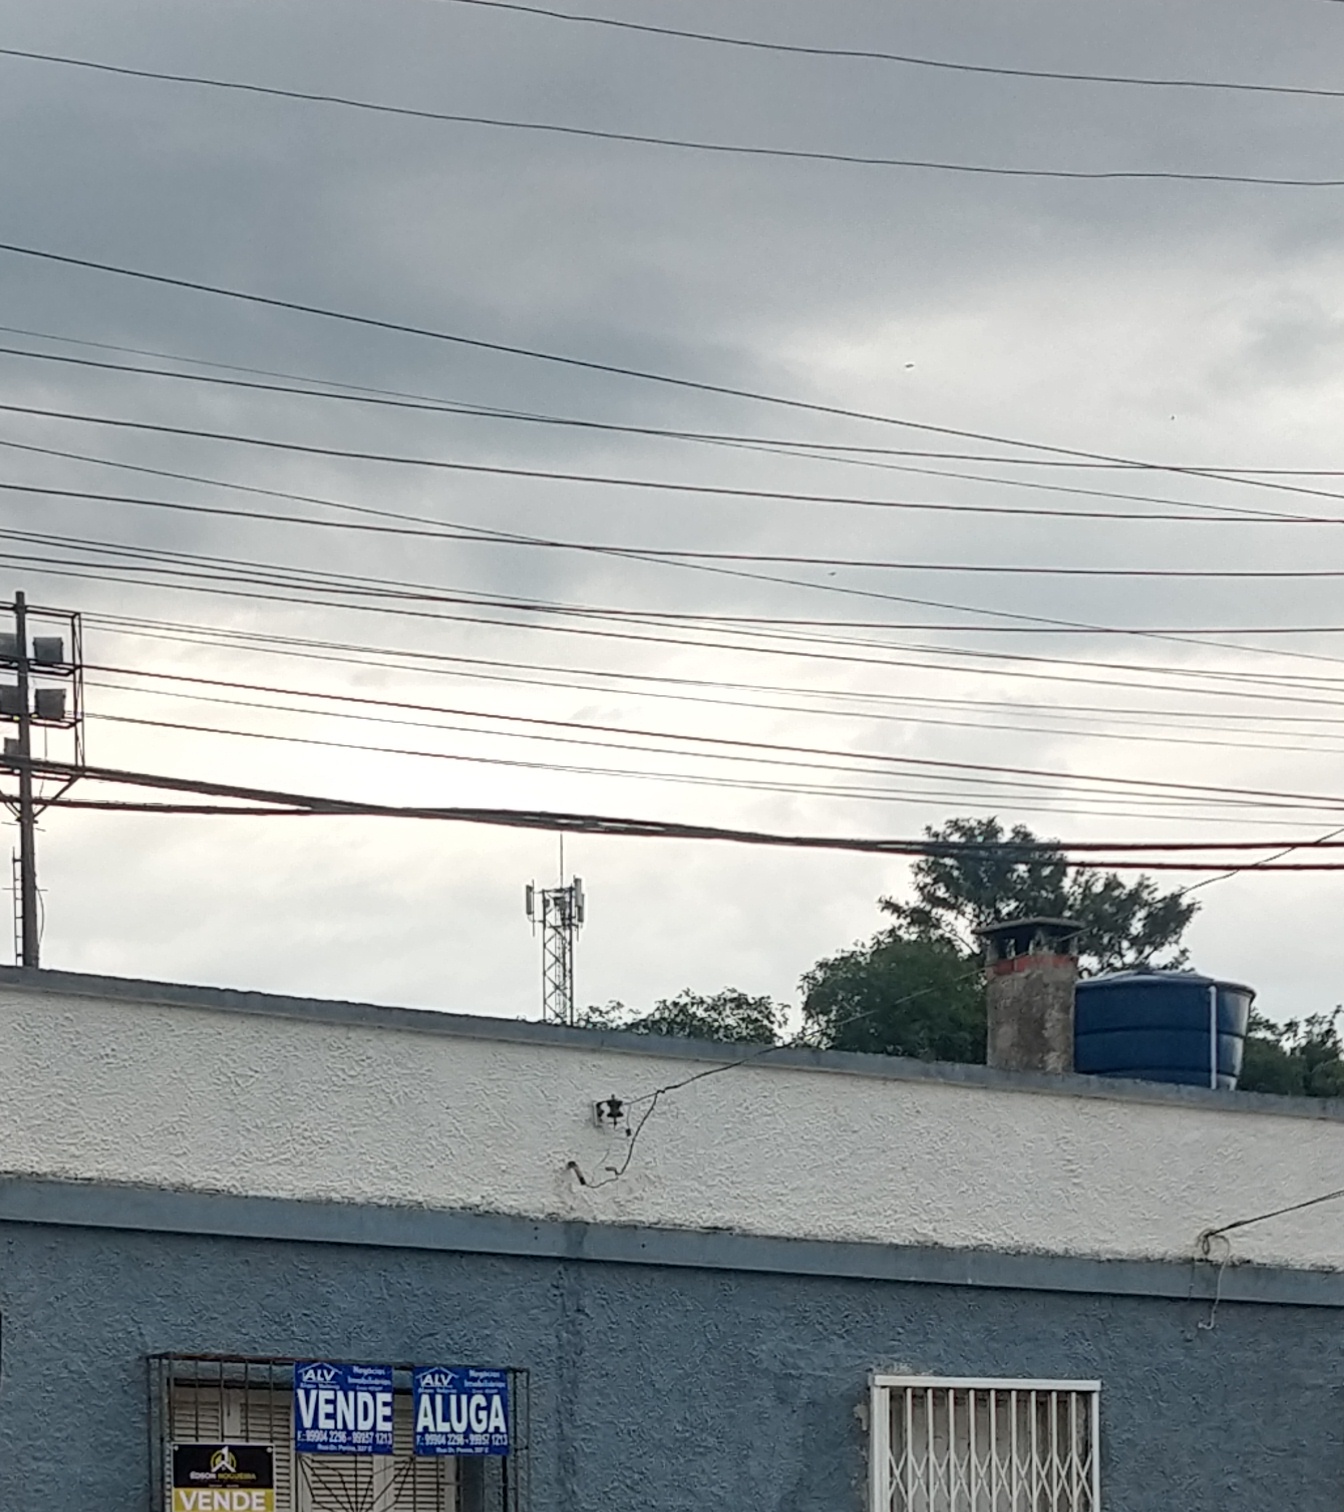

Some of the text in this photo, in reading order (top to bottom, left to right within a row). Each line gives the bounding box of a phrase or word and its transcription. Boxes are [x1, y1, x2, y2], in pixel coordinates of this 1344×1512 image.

[302, 1369, 336, 1382] ALV
[420, 1373, 453, 1386] ALV
[297, 1388, 393, 1432] VENDE
[416, 1393, 507, 1434] ALUGA
[179, 1490, 266, 1511] VENDE
